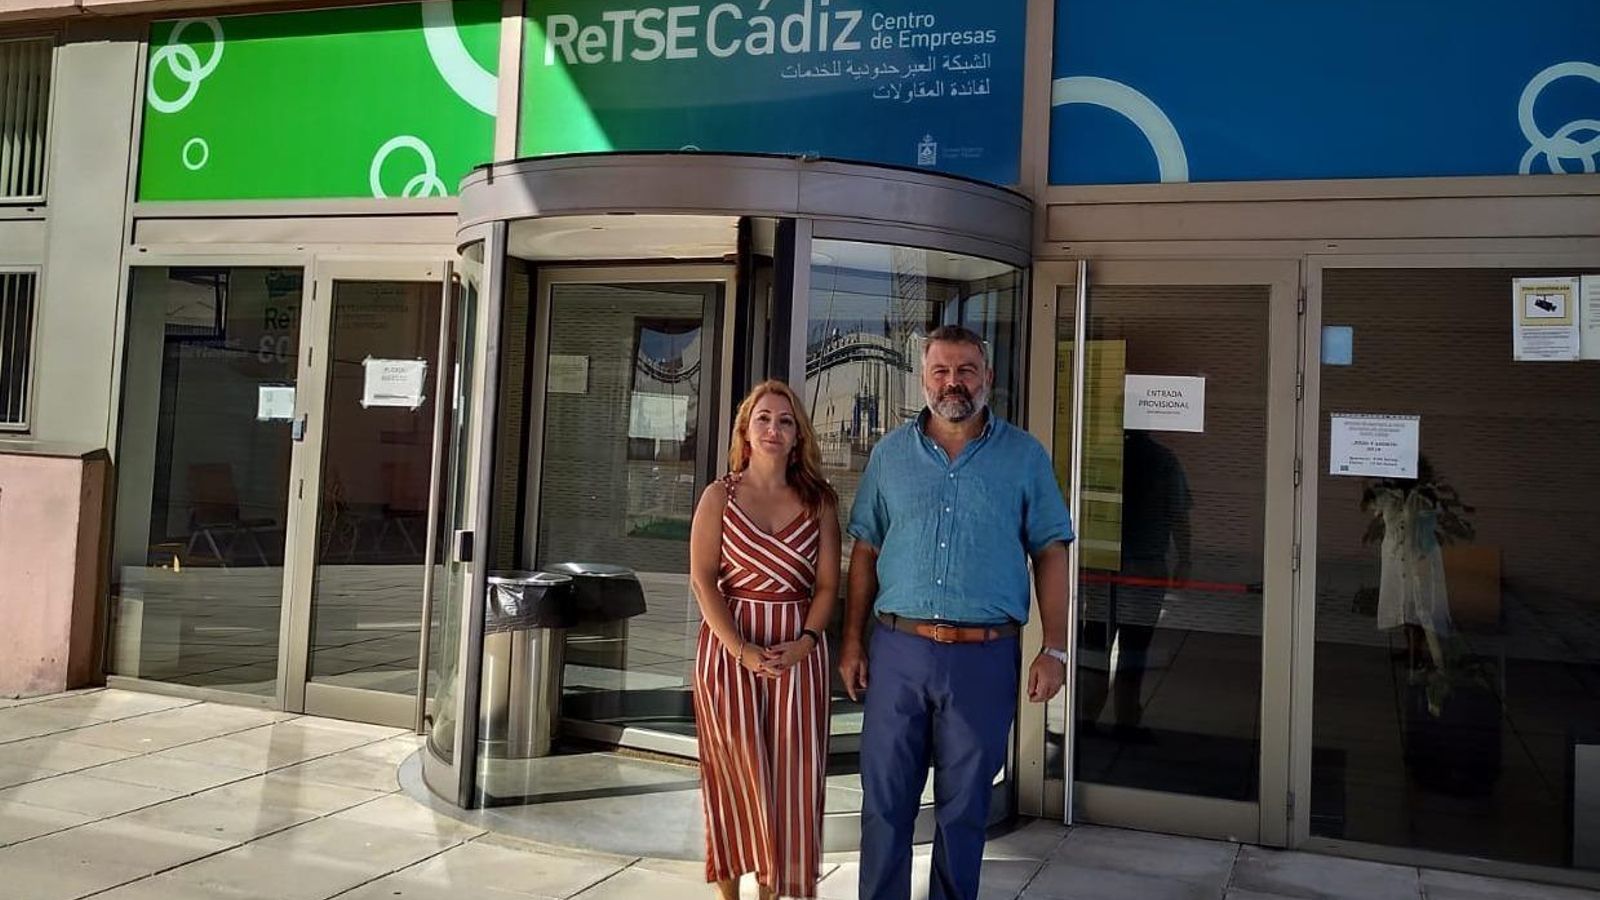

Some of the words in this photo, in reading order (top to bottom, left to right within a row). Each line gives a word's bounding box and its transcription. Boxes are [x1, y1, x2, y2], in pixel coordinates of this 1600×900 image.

[871, 12, 935, 31] Centro
[544, 5, 700, 66] ReTSE
[706, 0, 863, 57] Cádiz
[870, 32, 893, 49] de
[899, 29, 997, 51] Empresas
[781, 60, 841, 79] للخدمات
[942, 52, 991, 73] الشبكة
[873, 81, 944, 103] المقاولات
[950, 78, 991, 97] لفائدة
[1146, 389, 1183, 398] ENTRADA
[1138, 399, 1190, 409] PROVISIONAL
